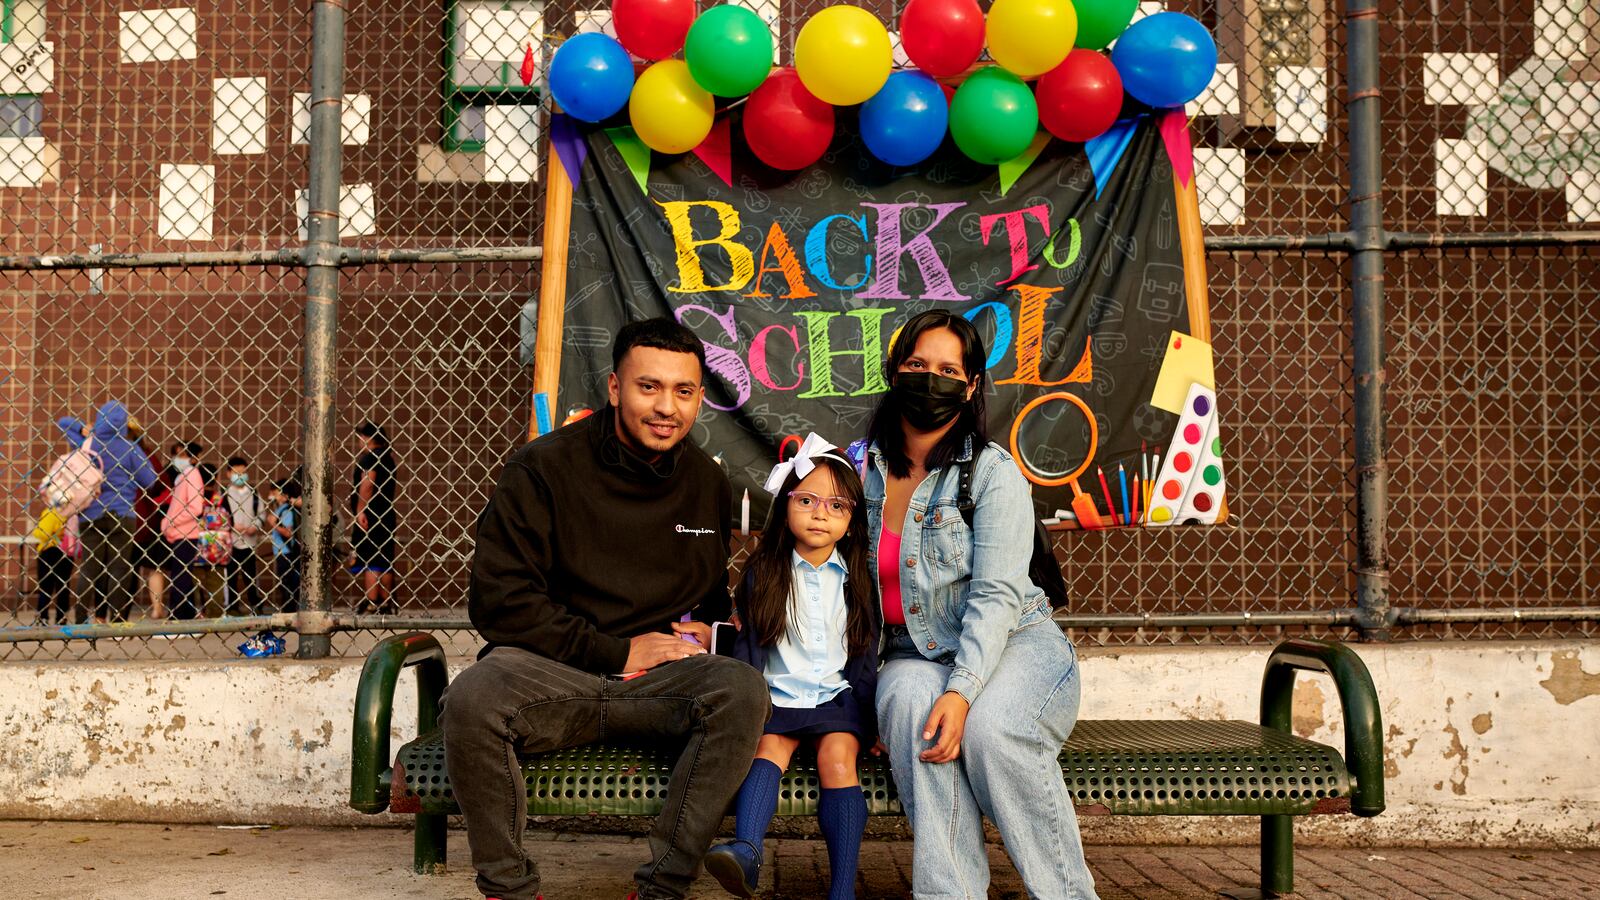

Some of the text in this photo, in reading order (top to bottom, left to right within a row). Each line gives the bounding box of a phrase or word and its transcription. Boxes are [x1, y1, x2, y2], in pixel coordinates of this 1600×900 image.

[652, 197, 972, 301] BACK
[675, 284, 1092, 412] SCHOL
[675, 524, 716, 537] Champion
